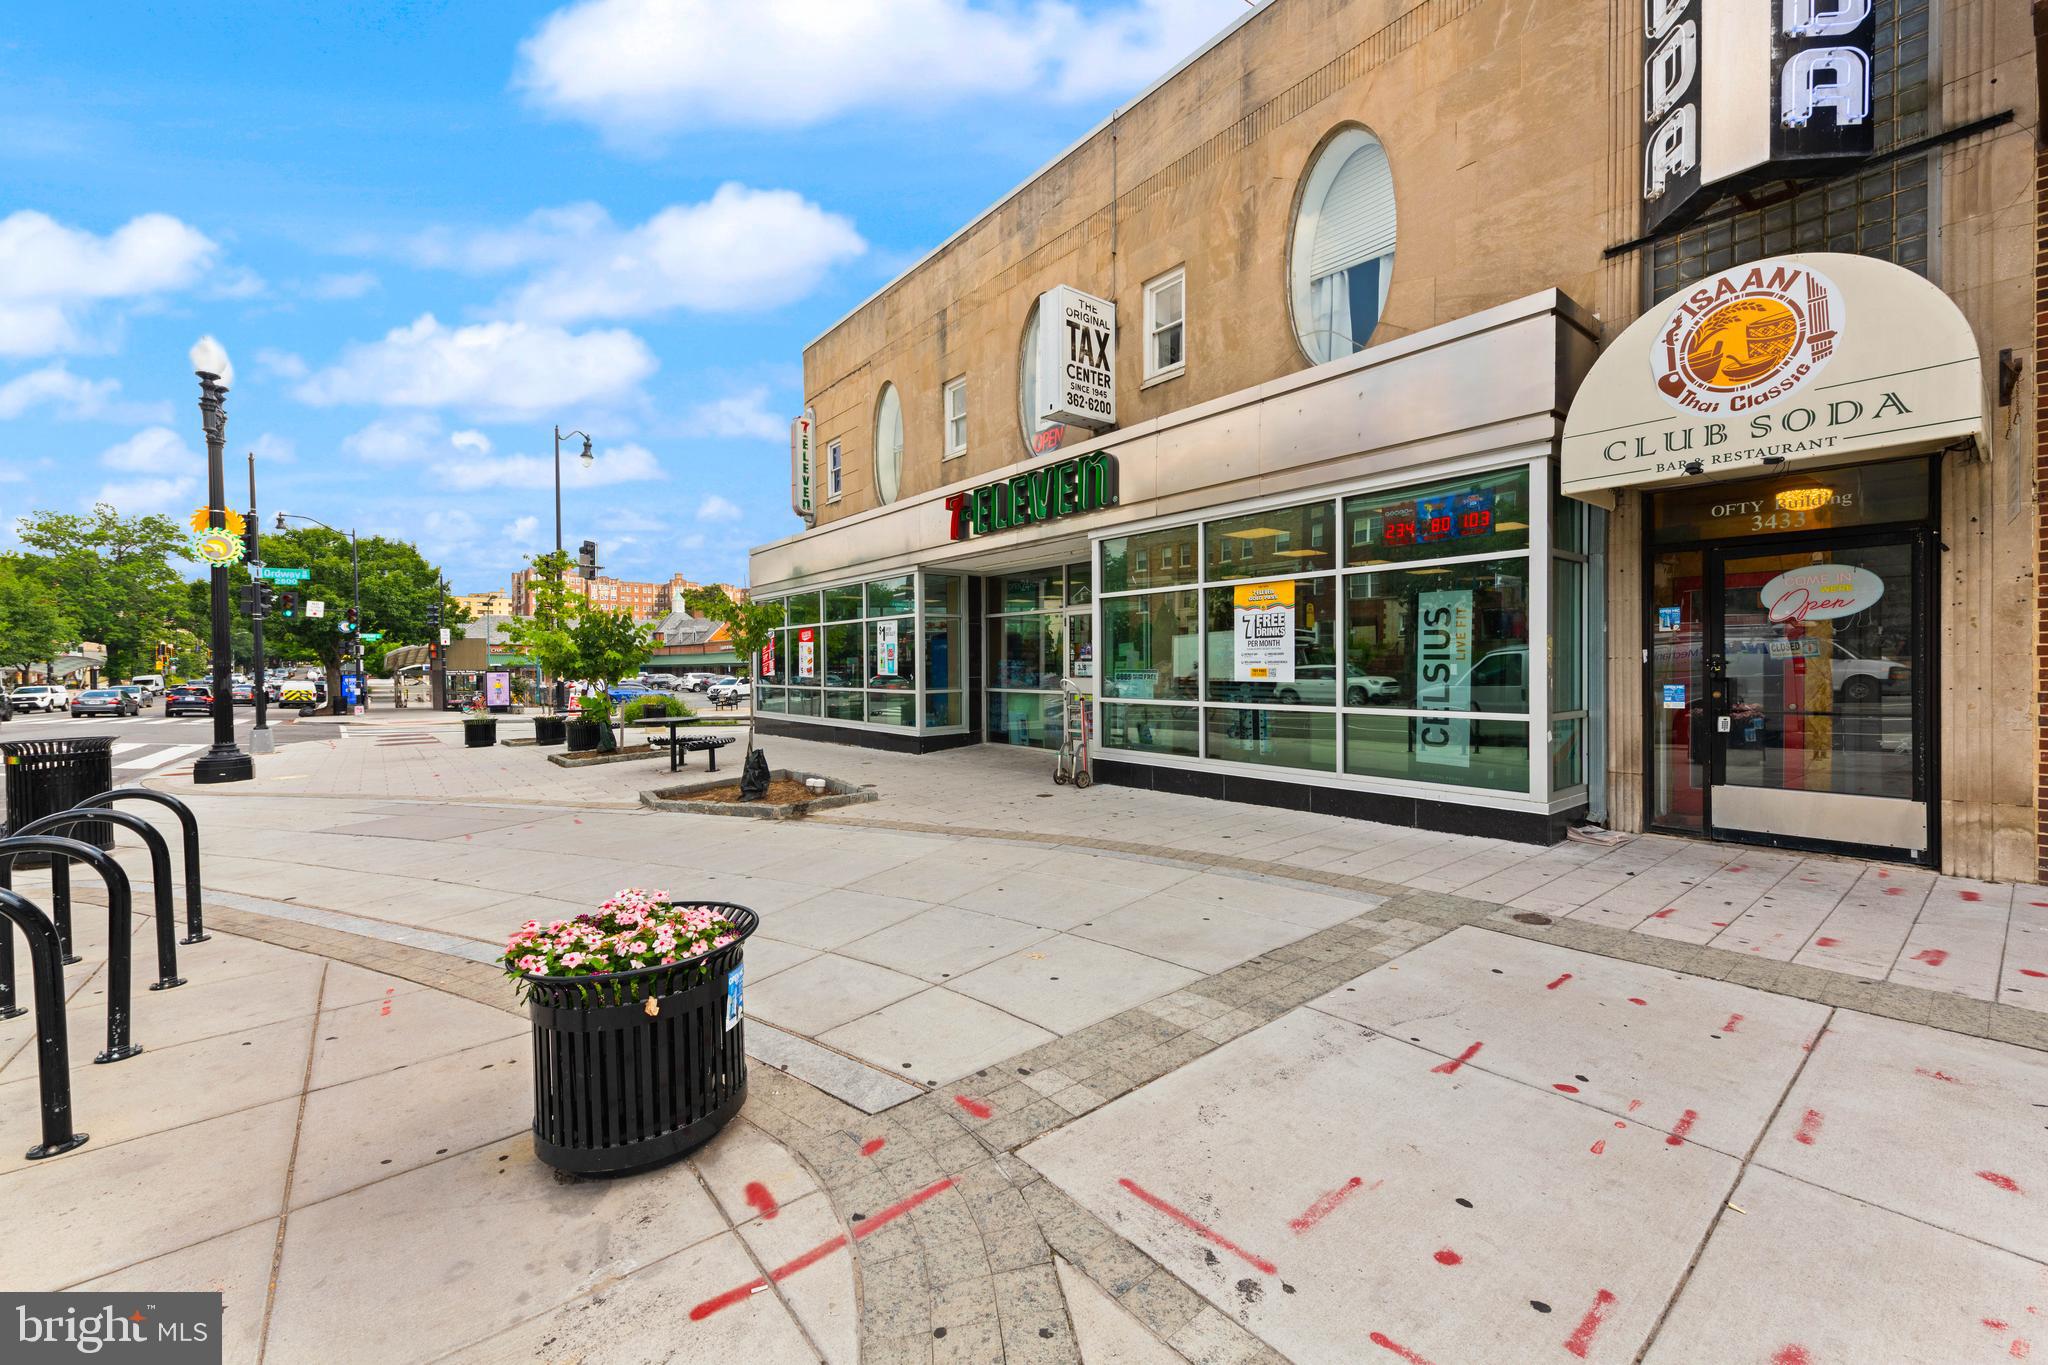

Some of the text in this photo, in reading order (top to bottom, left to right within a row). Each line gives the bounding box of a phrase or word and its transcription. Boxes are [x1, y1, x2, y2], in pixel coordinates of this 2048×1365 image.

[1679, 266, 1802, 320] ISAAN
[1065, 307, 1111, 331] ORIGINAL
[1078, 298, 1098, 315] THE
[1065, 319, 1111, 372] TAX
[1066, 363, 1111, 389] CENTER
[1070, 381, 1090, 394] SINCE
[1678, 362, 1811, 413] Thai Classic
[1033, 424, 1064, 453] OPEN
[1603, 391, 1913, 462] CLUB SODA
[1656, 460, 1687, 474] BAR
[1711, 435, 1838, 465] RESTAURANT
[1711, 492, 1853, 518] OFTY Building
[1385, 520, 1416, 539] 234
[1431, 516, 1451, 533] 80
[1463, 510, 1491, 528] 103
[1751, 511, 1806, 532] 3433
[263, 569, 301, 580] Ordway
[1785, 572, 1852, 586] COME IN
[1769, 588, 1856, 622] Open
[1243, 612, 1286, 639] 7 FREE
[1256, 626, 1287, 638] DRINKS
[1456, 606, 1468, 661] LIVE FIT
[1247, 639, 1281, 648] PER MONTH
[1771, 641, 1801, 652] CLOSED
[1421, 603, 1452, 748] CELSIUS
